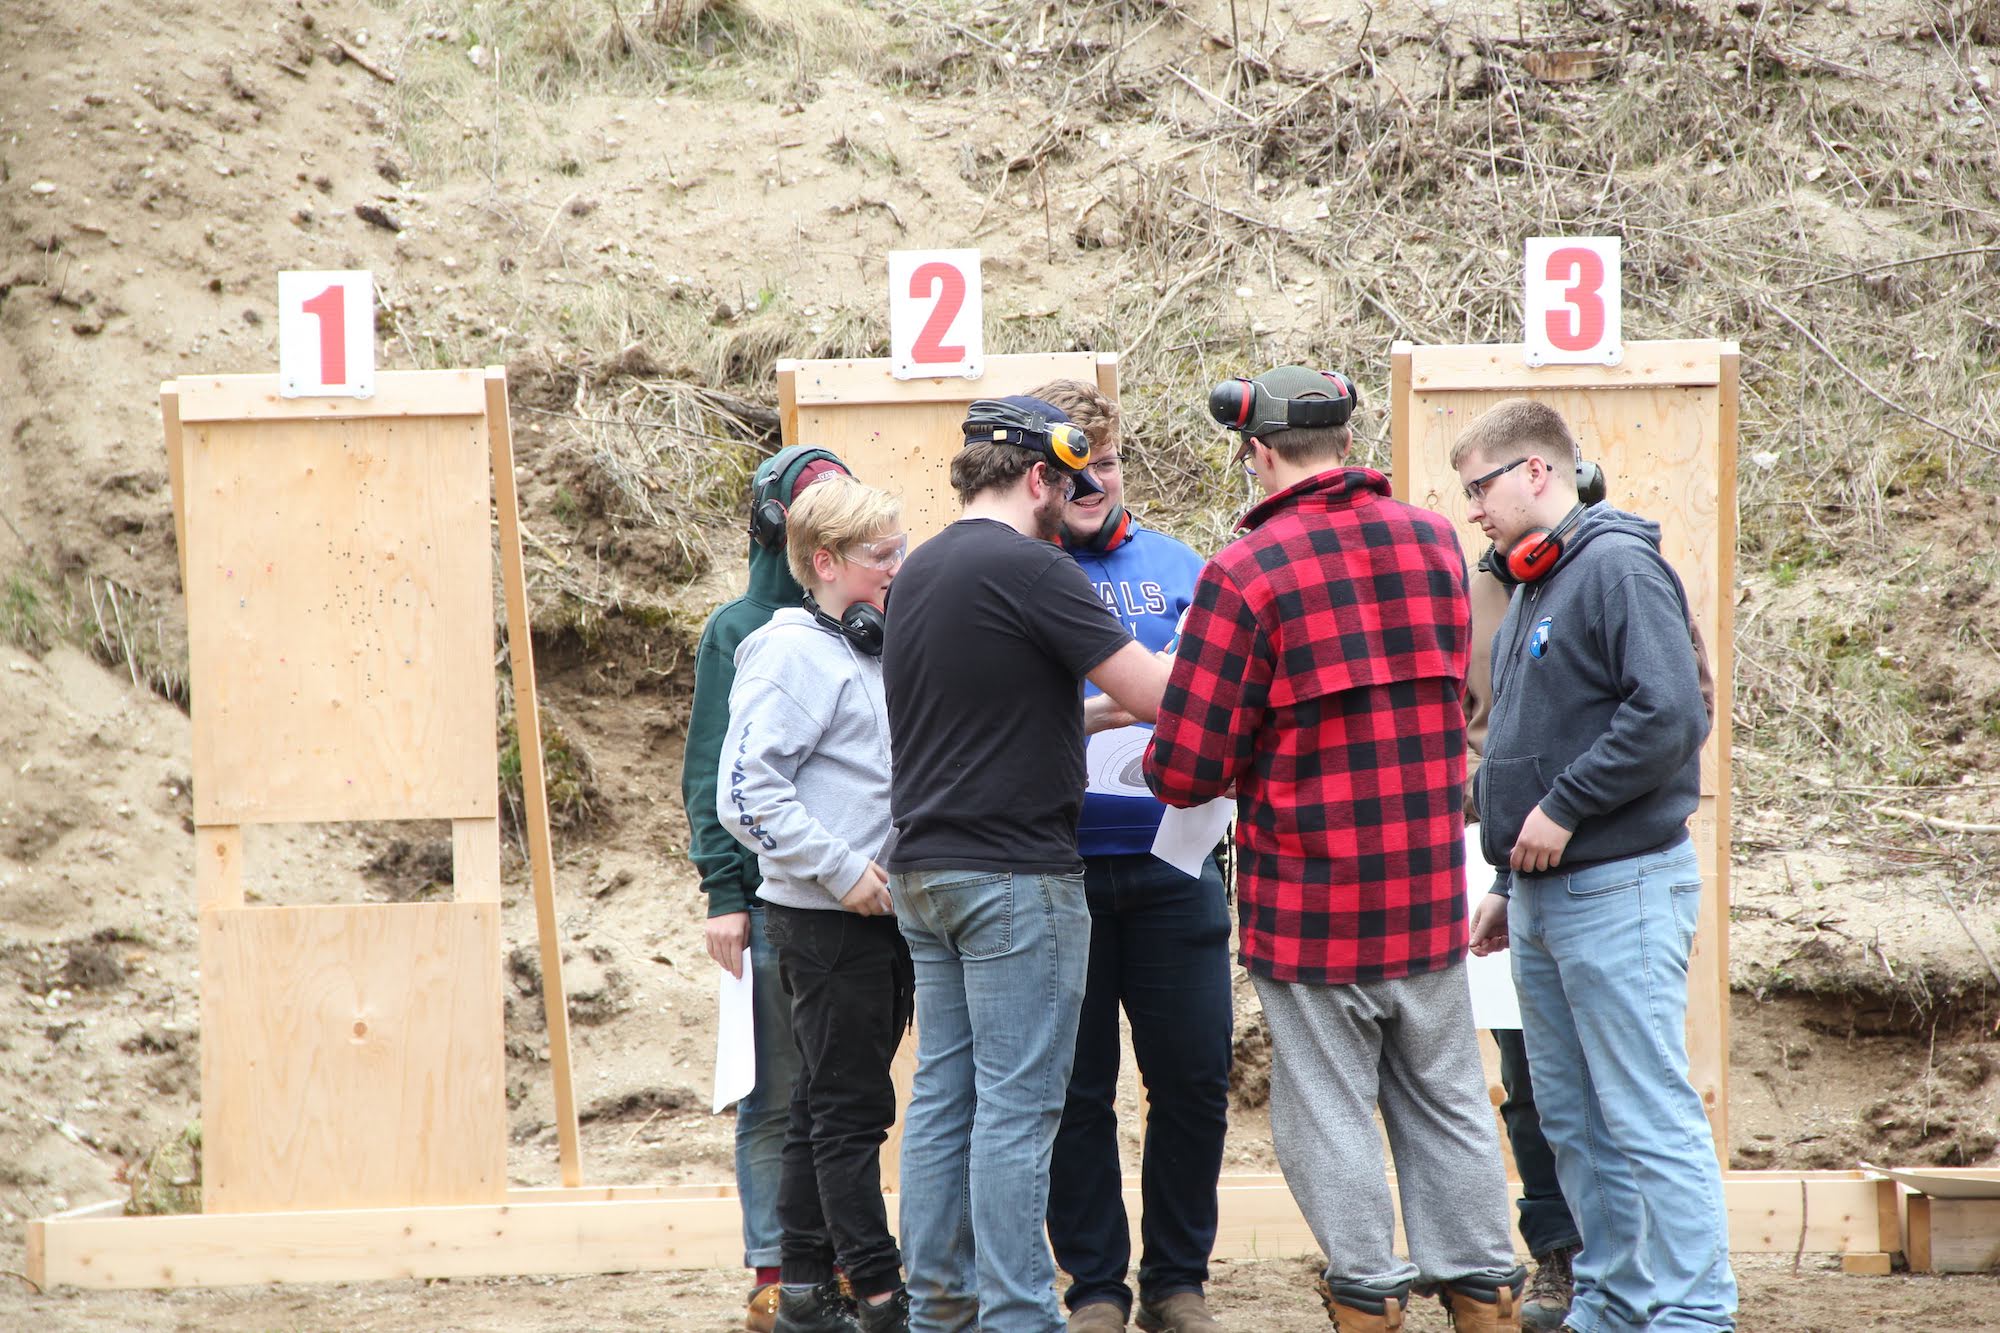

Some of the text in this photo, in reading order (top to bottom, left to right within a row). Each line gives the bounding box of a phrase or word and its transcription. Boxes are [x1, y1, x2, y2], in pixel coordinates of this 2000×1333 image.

[301, 285, 346, 385] 1
[909, 262, 966, 364] 2
[1545, 247, 1604, 351] 3
[1091, 581, 1167, 617] ALS
